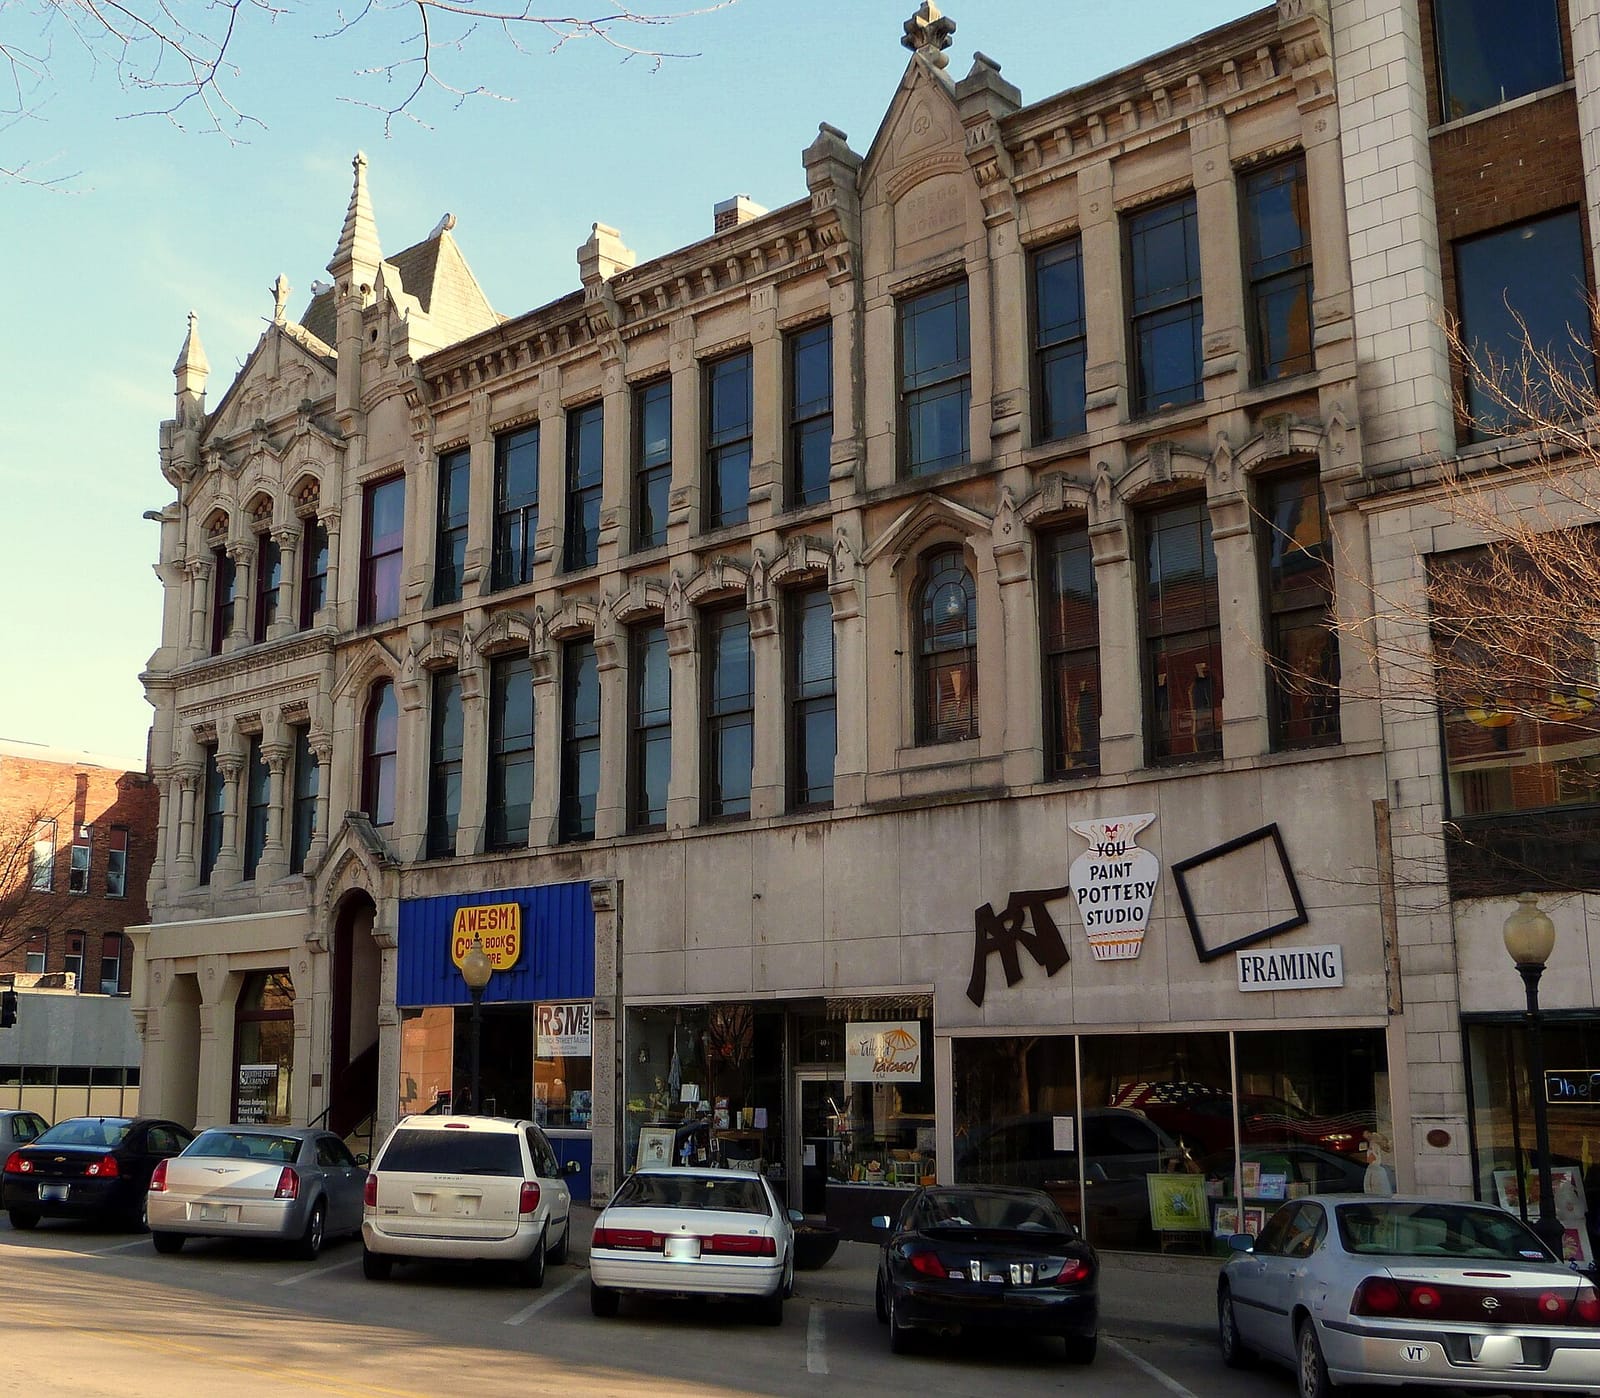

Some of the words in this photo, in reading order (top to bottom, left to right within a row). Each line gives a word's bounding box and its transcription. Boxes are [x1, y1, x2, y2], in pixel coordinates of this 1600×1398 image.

[1097, 840, 1126, 857] YOU
[1090, 862, 1133, 881] PAINT
[1077, 880, 1155, 905] POTTERY
[1087, 906, 1144, 926] STUDIO
[485, 934, 516, 956] BOOKS
[966, 885, 1070, 1008] ART
[1240, 951, 1336, 983] FRAMING
[539, 1006, 583, 1036] RSM
[582, 1006, 590, 1035] INC
[872, 1055, 919, 1073] Parasol
[1407, 1346, 1424, 1361] VT
